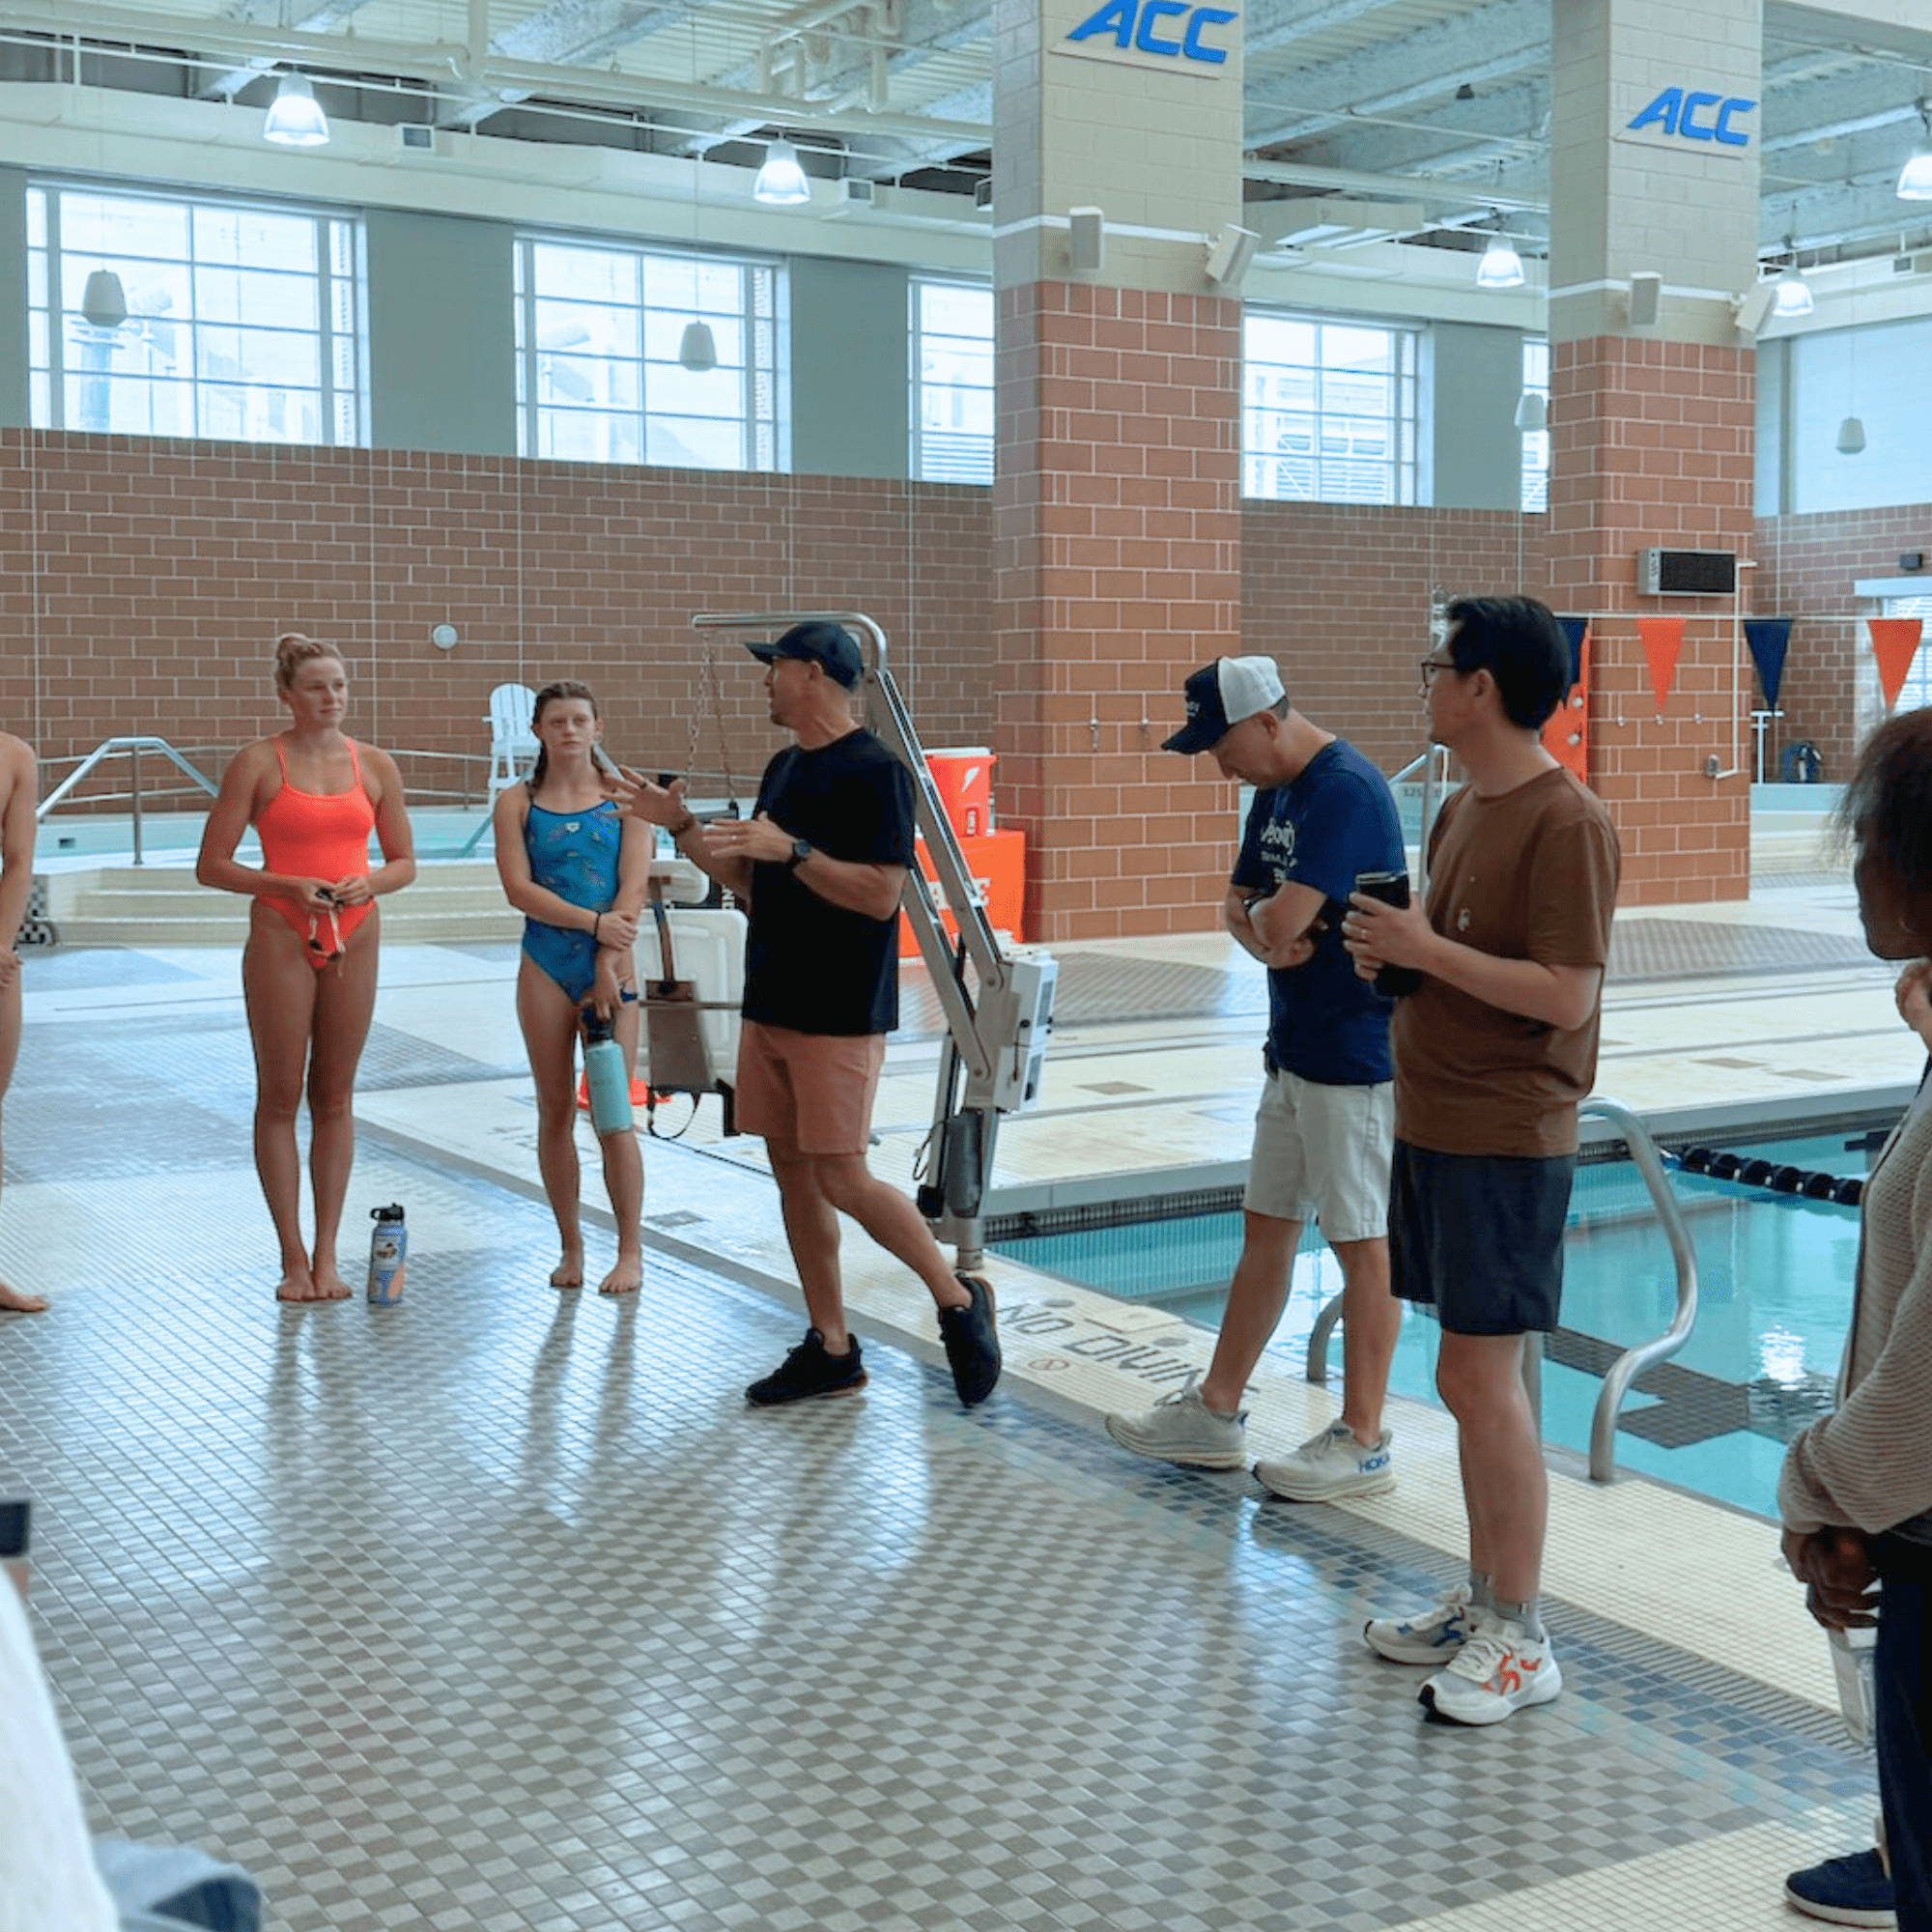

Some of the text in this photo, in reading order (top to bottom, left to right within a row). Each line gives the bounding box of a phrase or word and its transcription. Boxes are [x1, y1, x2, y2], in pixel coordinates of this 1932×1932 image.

[1065, 0, 1238, 64] ACC
[1626, 87, 1757, 146] ACC
[995, 1303, 1260, 1393] NO DIVIN
